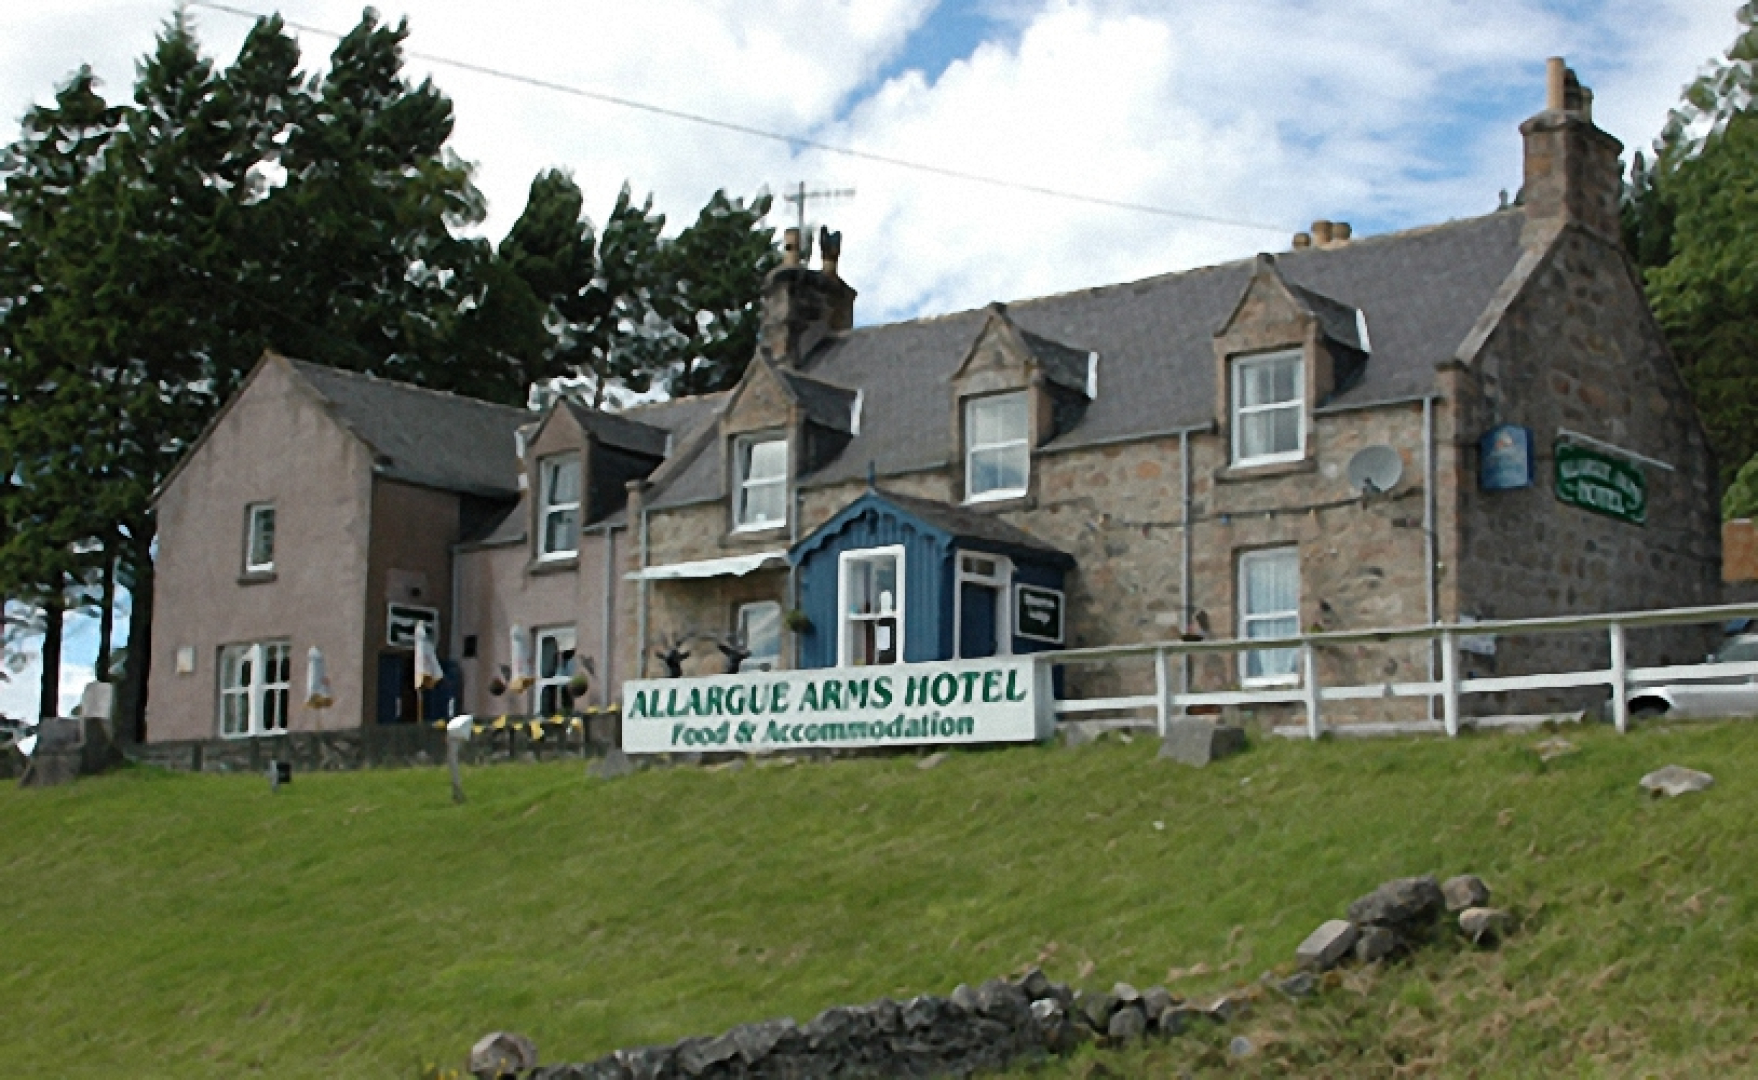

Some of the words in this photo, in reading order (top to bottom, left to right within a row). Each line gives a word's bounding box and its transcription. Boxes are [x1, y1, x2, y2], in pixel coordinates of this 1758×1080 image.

[628, 680, 791, 719] ALLARGUE
[798, 675, 894, 711] ARMS
[905, 669, 1027, 707] HOTEL
[671, 721, 730, 745] Food
[734, 720, 758, 744] &
[763, 709, 975, 743] Accommodation
